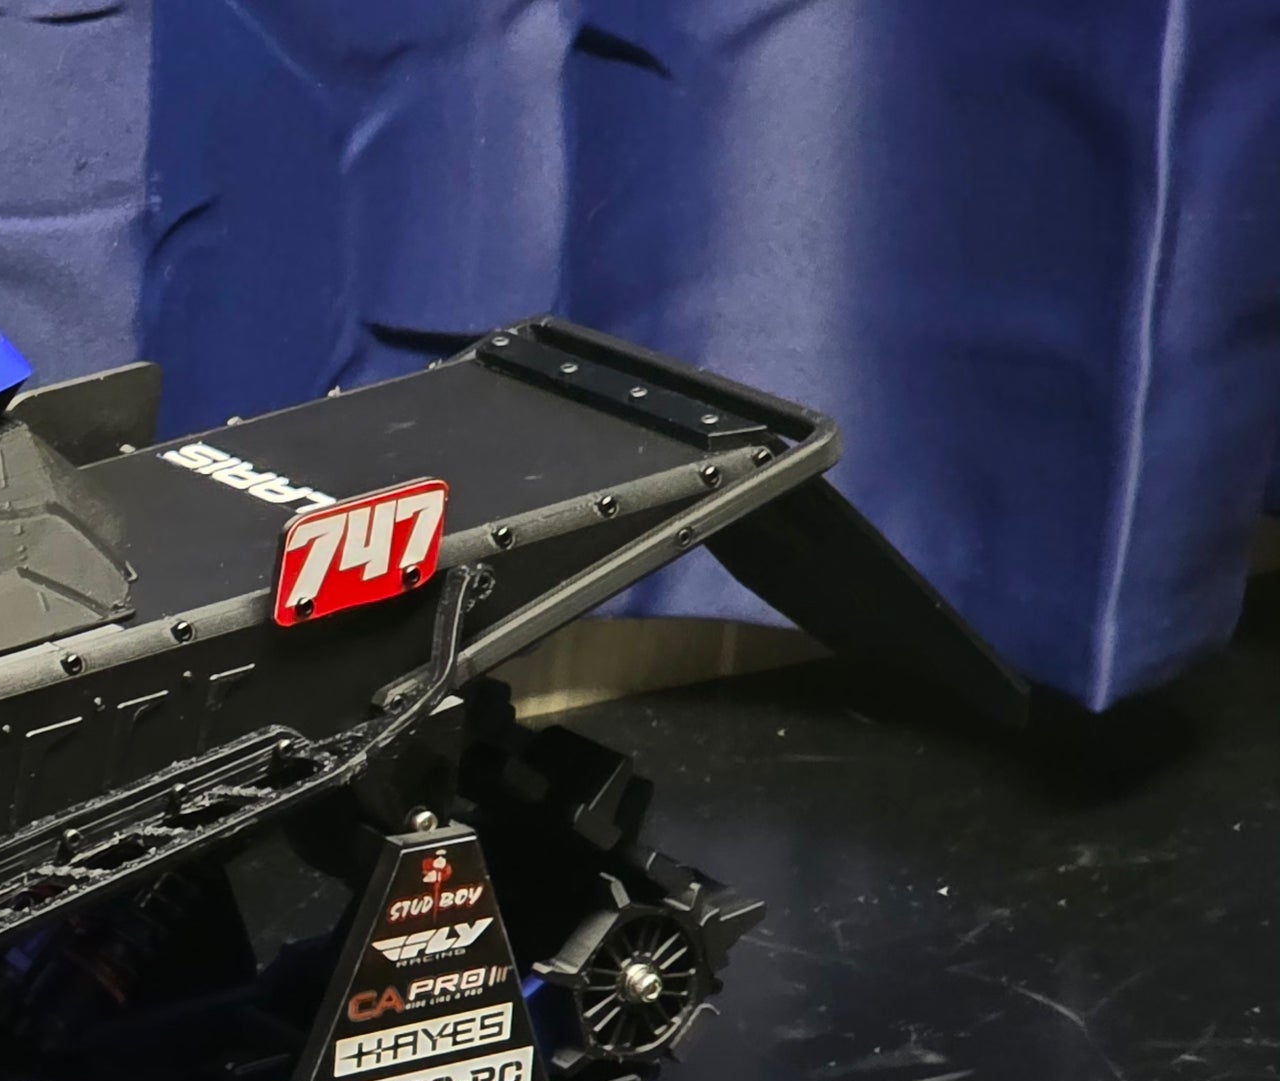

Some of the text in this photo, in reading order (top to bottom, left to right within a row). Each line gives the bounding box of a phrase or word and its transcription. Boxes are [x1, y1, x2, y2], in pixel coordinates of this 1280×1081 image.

[156, 441, 336, 514] LARIS
[285, 489, 445, 608] 747
[390, 886, 483, 922] STUD BOY
[371, 916, 495, 962] FLY
[396, 947, 467, 969] RACING
[339, 1011, 506, 1069] HAYES
